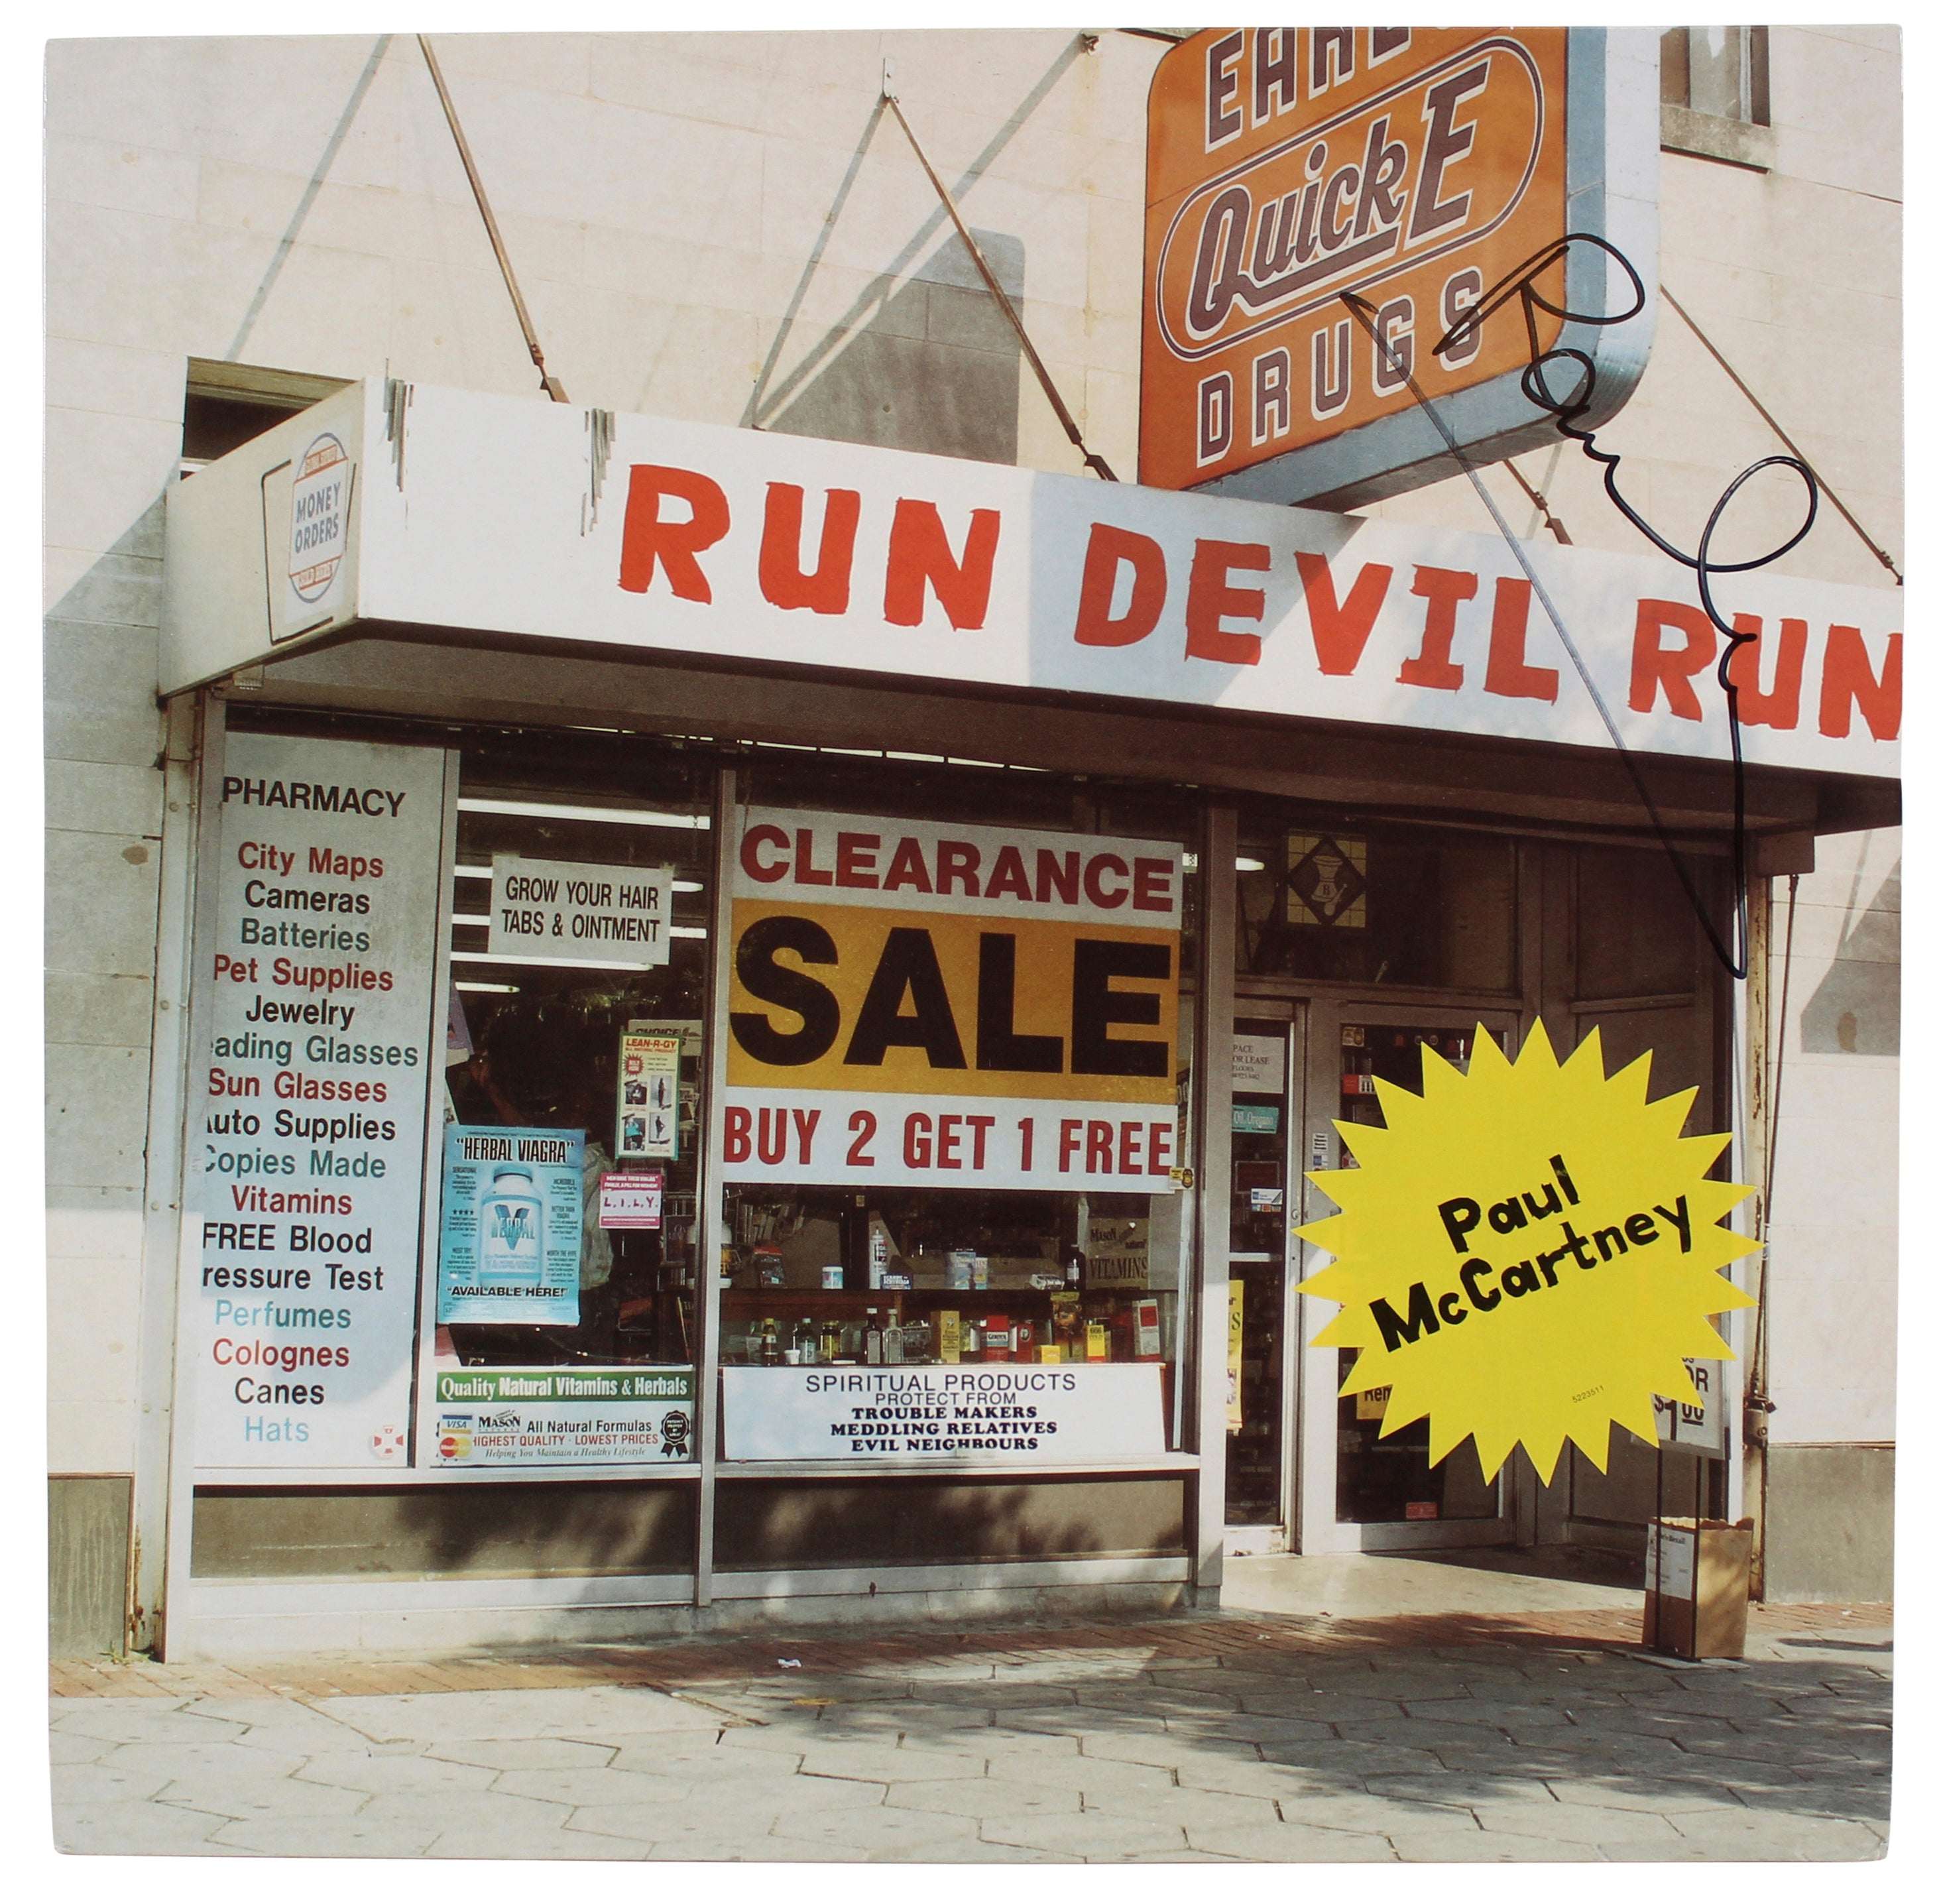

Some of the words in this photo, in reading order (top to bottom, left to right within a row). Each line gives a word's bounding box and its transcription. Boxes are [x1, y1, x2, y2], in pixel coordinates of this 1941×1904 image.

[1196, 267, 1484, 469] DRUGS
[296, 481, 341, 524] MONEY
[294, 513, 339, 554] ORDERS
[618, 464, 1000, 631] RUN
[1074, 522, 1559, 706] DEVIL
[1627, 598, 1903, 743] RUN
[222, 776, 406, 817] PHARMACY
[238, 841, 295, 877] City
[309, 847, 384, 882] Maps
[740, 824, 1174, 912] CLEARANCE
[245, 880, 371, 914] Cameras
[506, 876, 559, 902] GROW
[566, 880, 612, 907] YOUR
[619, 885, 658, 910] HAIR
[241, 918, 371, 952] Batteries
[502, 909, 544, 935] TABS
[552, 913, 563, 936] &
[572, 914, 660, 942] OINTMENT
[213, 954, 258, 982] Pet
[272, 957, 393, 993] Supplies
[729, 915, 1171, 1077] SALE
[246, 995, 355, 1031] Jewelry
[211, 1032, 293, 1067] ading
[306, 1035, 418, 1067] Glasses
[626, 1038, 677, 1047] LEAN-R-GY
[1245, 1055, 1270, 1065] LEASE
[209, 1067, 260, 1097] Sun
[274, 1071, 387, 1102] Glasses
[274, 1108, 396, 1144] Supplies
[723, 1105, 821, 1165] BUY
[846, 1110, 877, 1166] 2
[903, 1112, 995, 1170] GET
[1018, 1117, 1033, 1172] 1
[1059, 1118, 1172, 1175] FREE
[310, 1150, 386, 1178] Made
[231, 1184, 353, 1215] Vitamins
[1438, 1154, 1580, 1254] Paul
[203, 1222, 276, 1251] FREE
[290, 1225, 372, 1254] Blood
[325, 1264, 384, 1291] Test
[1089, 1257, 1147, 1279] VITAMINS
[1369, 1194, 1692, 1353] McCartney
[215, 1299, 351, 1329] Perfumes
[213, 1338, 349, 1372] Colognes
[235, 1377, 325, 1405] Canes
[441, 1377, 496, 1401] Quality
[499, 1376, 552, 1396] Natural
[556, 1376, 618, 1396] Vitamins
[621, 1379, 632, 1396] &
[634, 1376, 687, 1396] Herbals
[805, 1374, 935, 1392] SPIRITUAL
[944, 1373, 1076, 1392] PRODUCTS
[1572, 1384, 1604, 1403] 5223511
[852, 1406, 947, 1421] TROUBLE
[953, 1405, 1037, 1419] MAKERS
[875, 1393, 960, 1406] PROTECT
[966, 1393, 1016, 1405] FROM
[245, 1415, 310, 1443] Hats
[447, 1420, 467, 1429] VISA
[473, 1435, 516, 1447] HIGHEST
[520, 1435, 565, 1447] QUALITY
[575, 1434, 618, 1445] LOWEST
[621, 1433, 659, 1445] PRICES
[527, 1421, 542, 1433] All
[547, 1420, 592, 1433] Natural
[596, 1419, 652, 1432] Formulas
[831, 1422, 940, 1436] MEDDLING
[947, 1421, 1057, 1435] RELATIVES
[485, 1448, 516, 1458] Helping
[520, 1449, 533, 1457] You
[537, 1448, 572, 1457] Maintain
[581, 1447, 612, 1458] Healthy
[614, 1447, 647, 1458] Lifestyle
[851, 1438, 900, 1452] EVIL
[906, 1437, 1038, 1451] NEIGHBOURS
